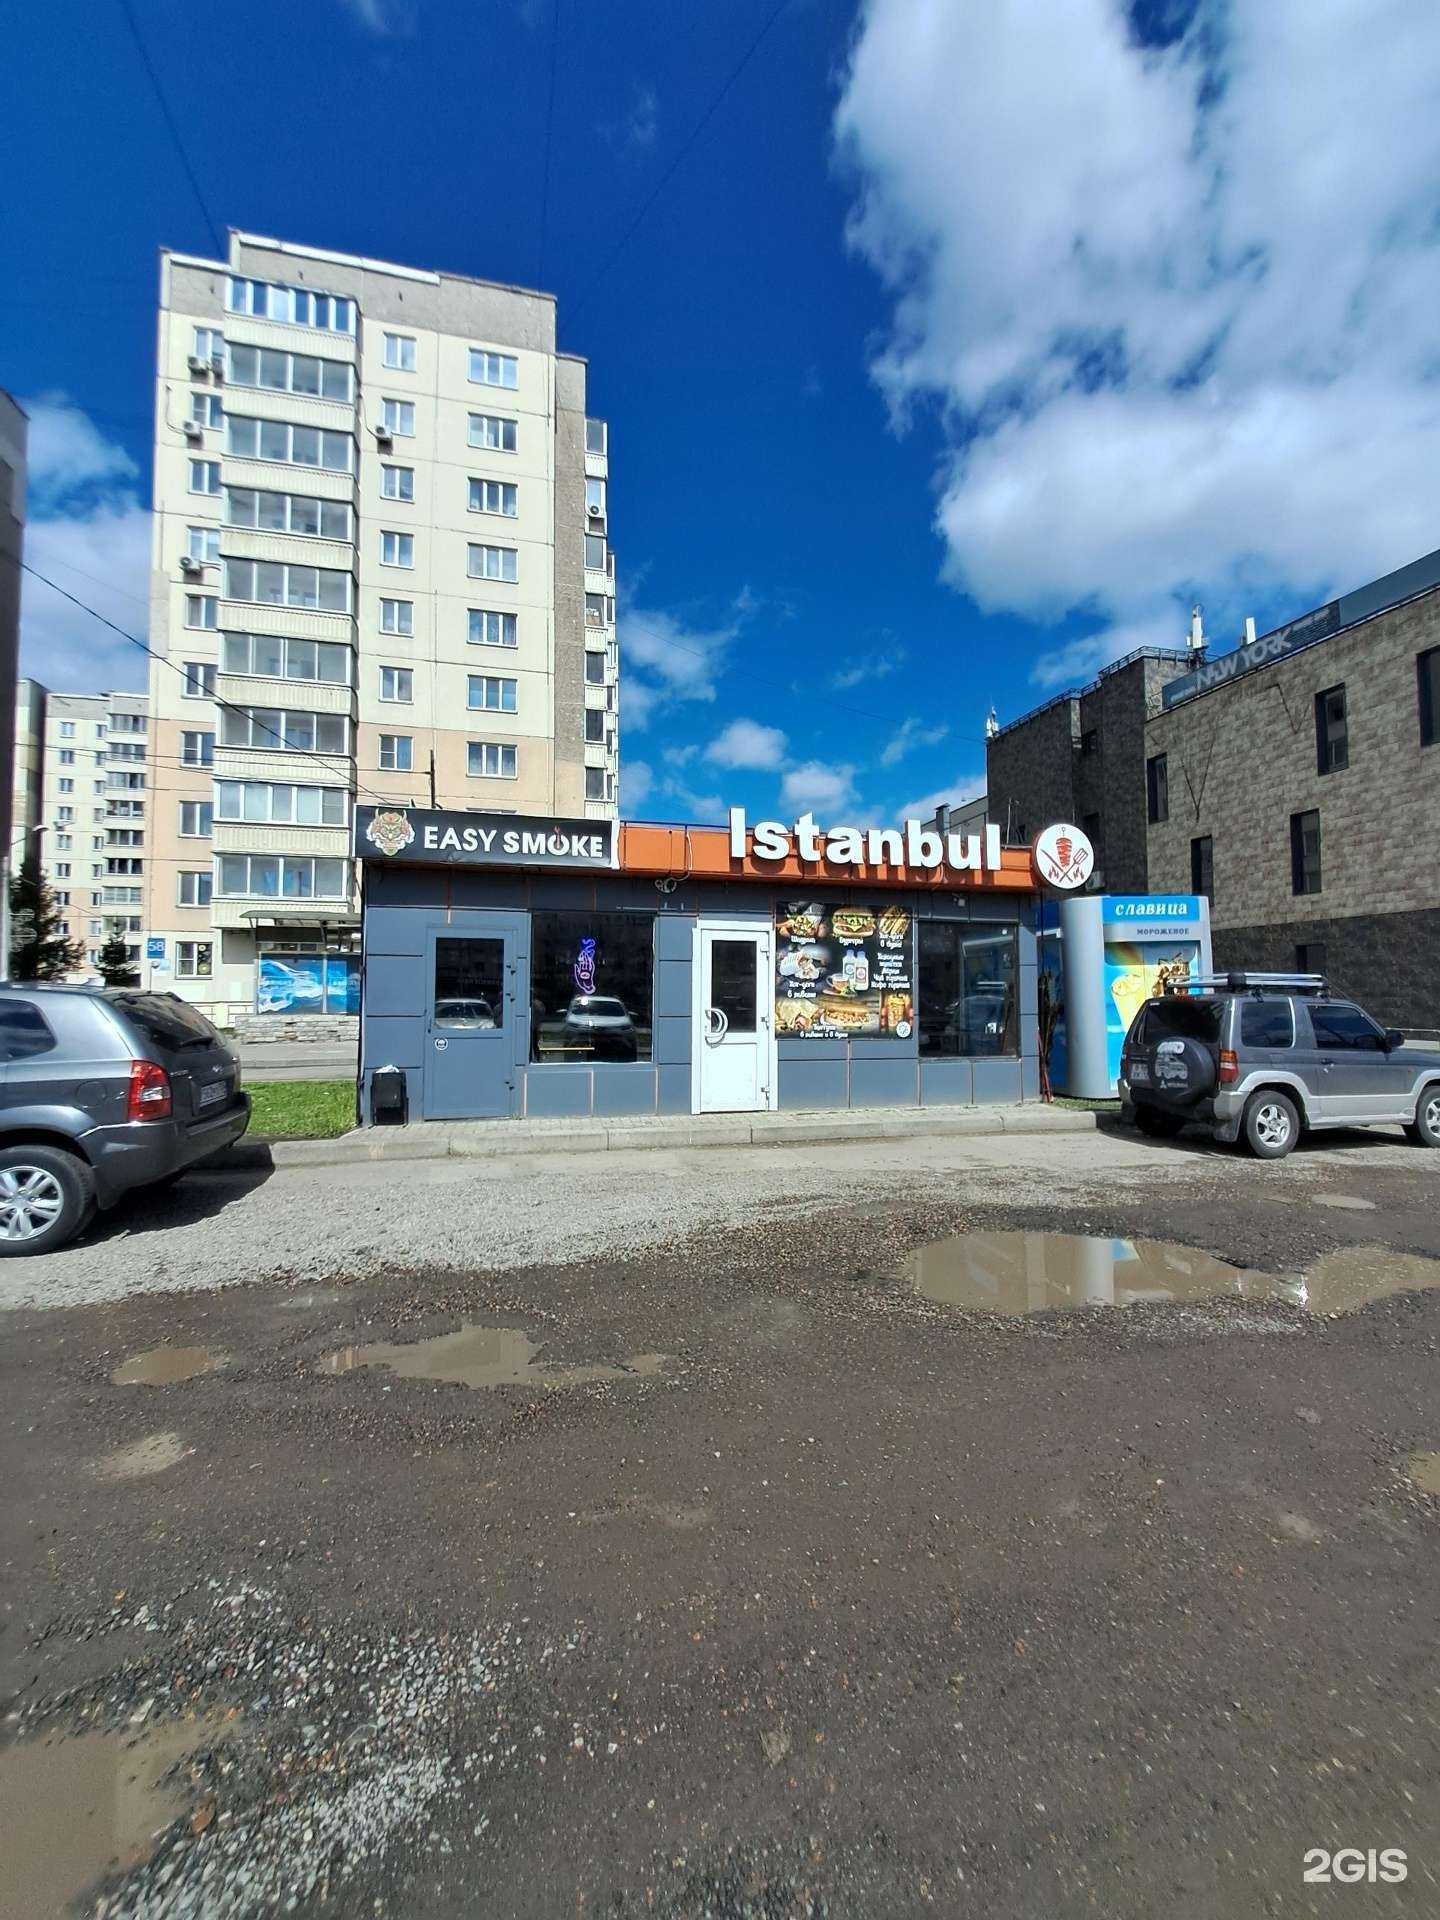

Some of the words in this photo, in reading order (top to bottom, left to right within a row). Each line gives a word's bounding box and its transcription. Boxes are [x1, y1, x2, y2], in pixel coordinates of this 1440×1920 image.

[1240, 627, 1293, 667] YORK
[424, 825, 497, 852] EASY
[503, 828, 603, 858] SMOKE
[729, 807, 1001, 871] Istanbul
[1115, 902, 1188, 916] славица
[1136, 928, 1190, 936] МОРОЖЕНОЕ
[148, 940, 165, 952] 58
